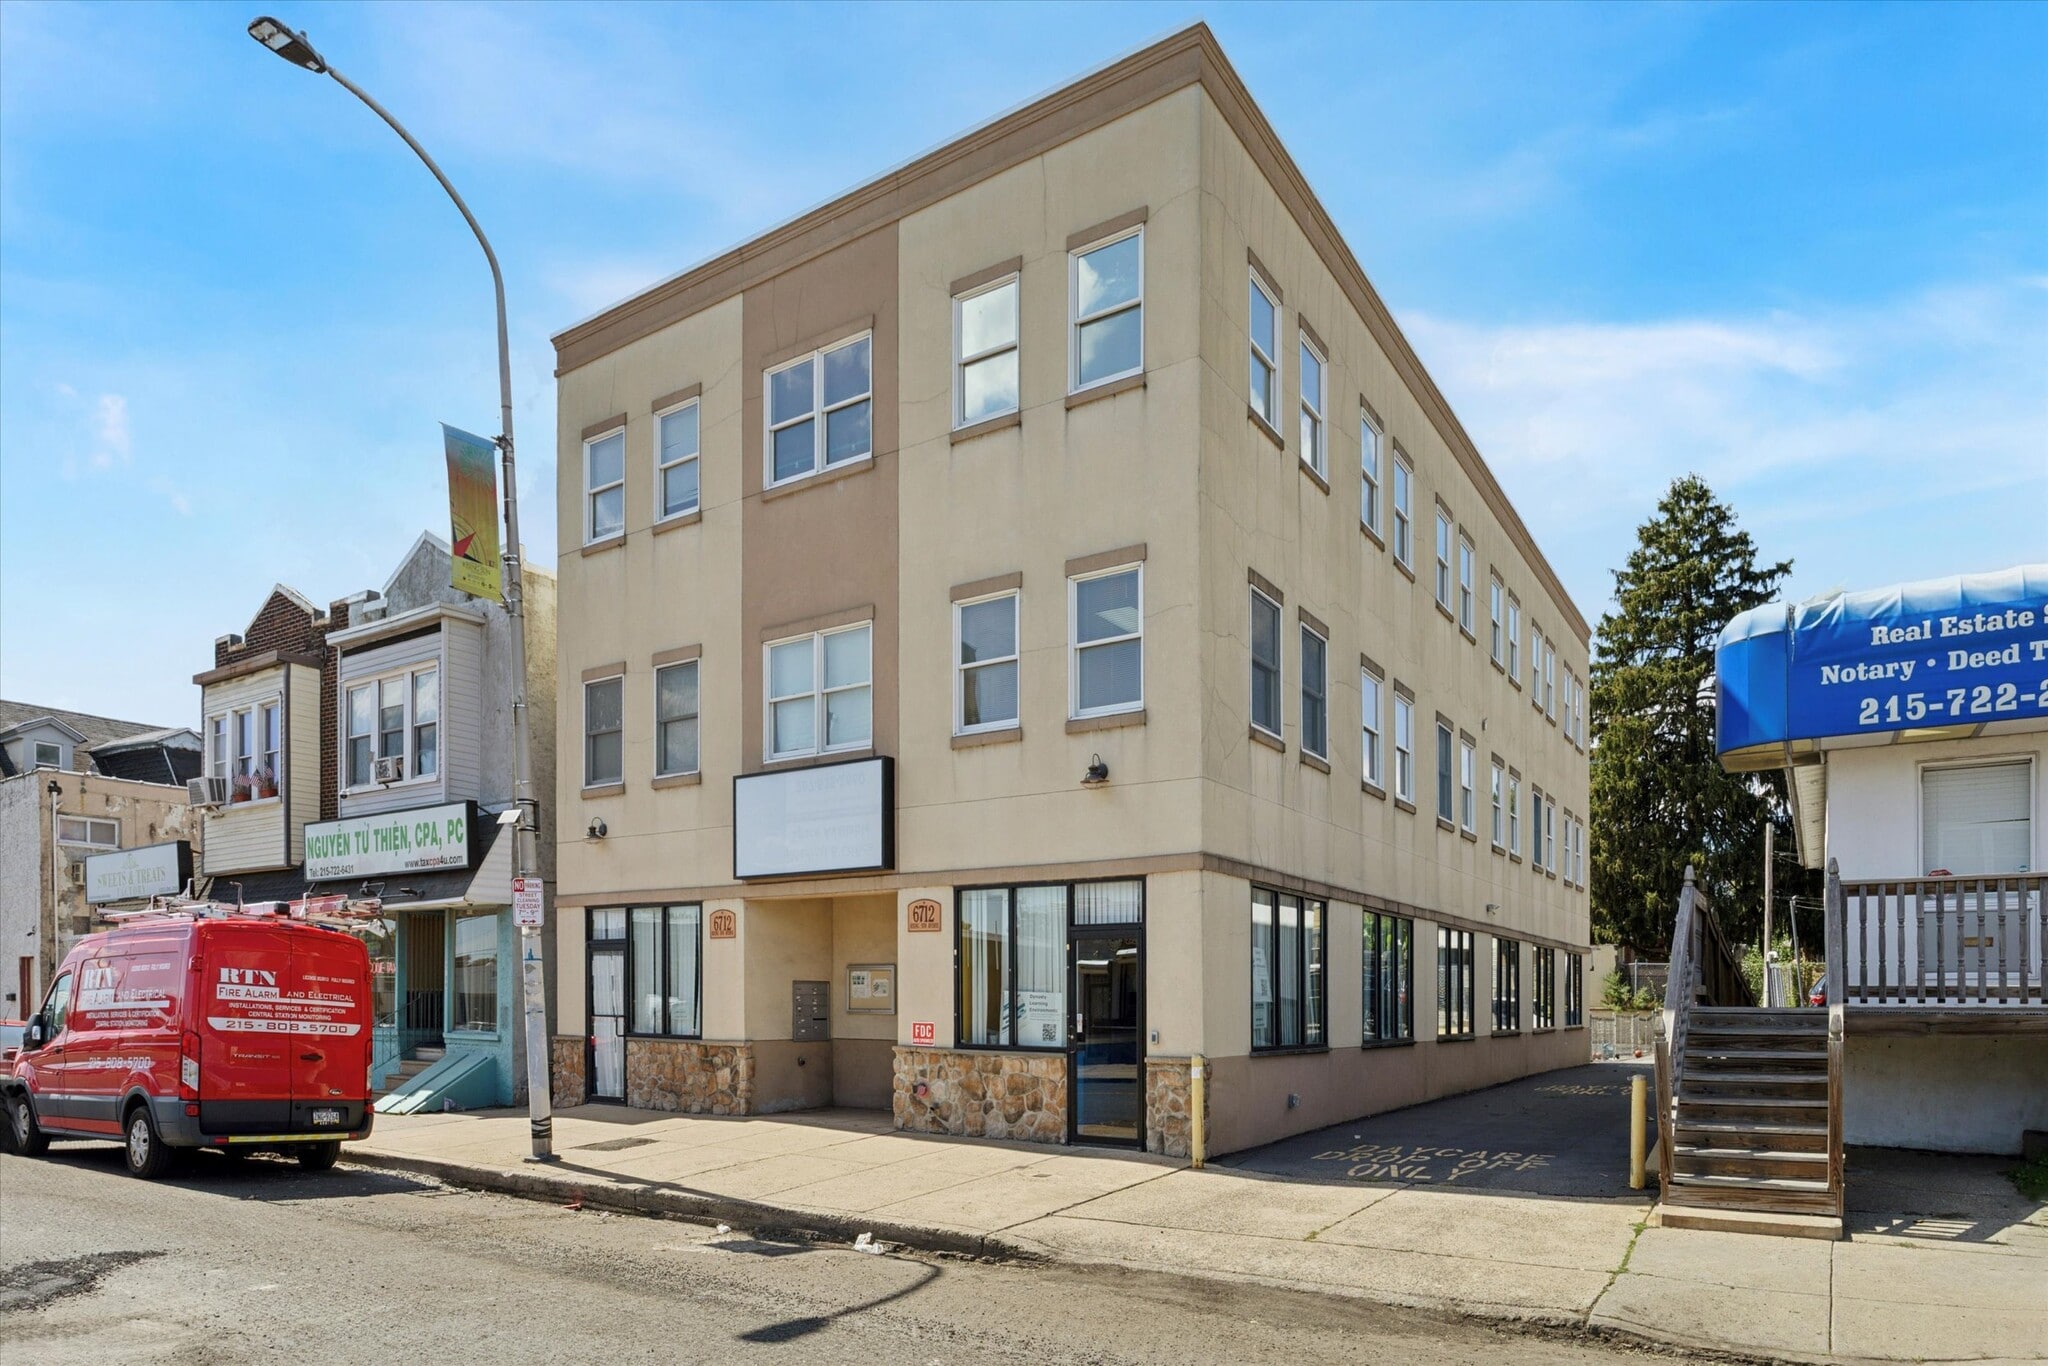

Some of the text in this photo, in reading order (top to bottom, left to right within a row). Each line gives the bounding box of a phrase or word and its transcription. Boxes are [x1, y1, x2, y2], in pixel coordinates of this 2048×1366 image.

[1870, 620, 1932, 646] Real
[1939, 609, 2034, 638] Estate
[1820, 659, 1916, 685] Notary
[1947, 644, 2020, 670] Deed
[415, 822, 442, 850] CPA,
[448, 817, 464, 844] PC
[404, 855, 463, 868] www.taxcpa4u.com
[96, 871, 126, 888] SWEETS
[136, 866, 166, 884] TREATS
[514, 880, 524, 890] NO
[913, 905, 934, 922] 6712
[714, 915, 732, 931] 6712
[218, 967, 277, 986] RTN
[228, 1002, 274, 1011] INSTALLATIONS,
[915, 1024, 932, 1037] FDC
[1311, 1151, 1550, 1171] DROP OFF
[1350, 1144, 1555, 1161] DAYCARE
[1347, 1163, 1477, 1180] ONLY
